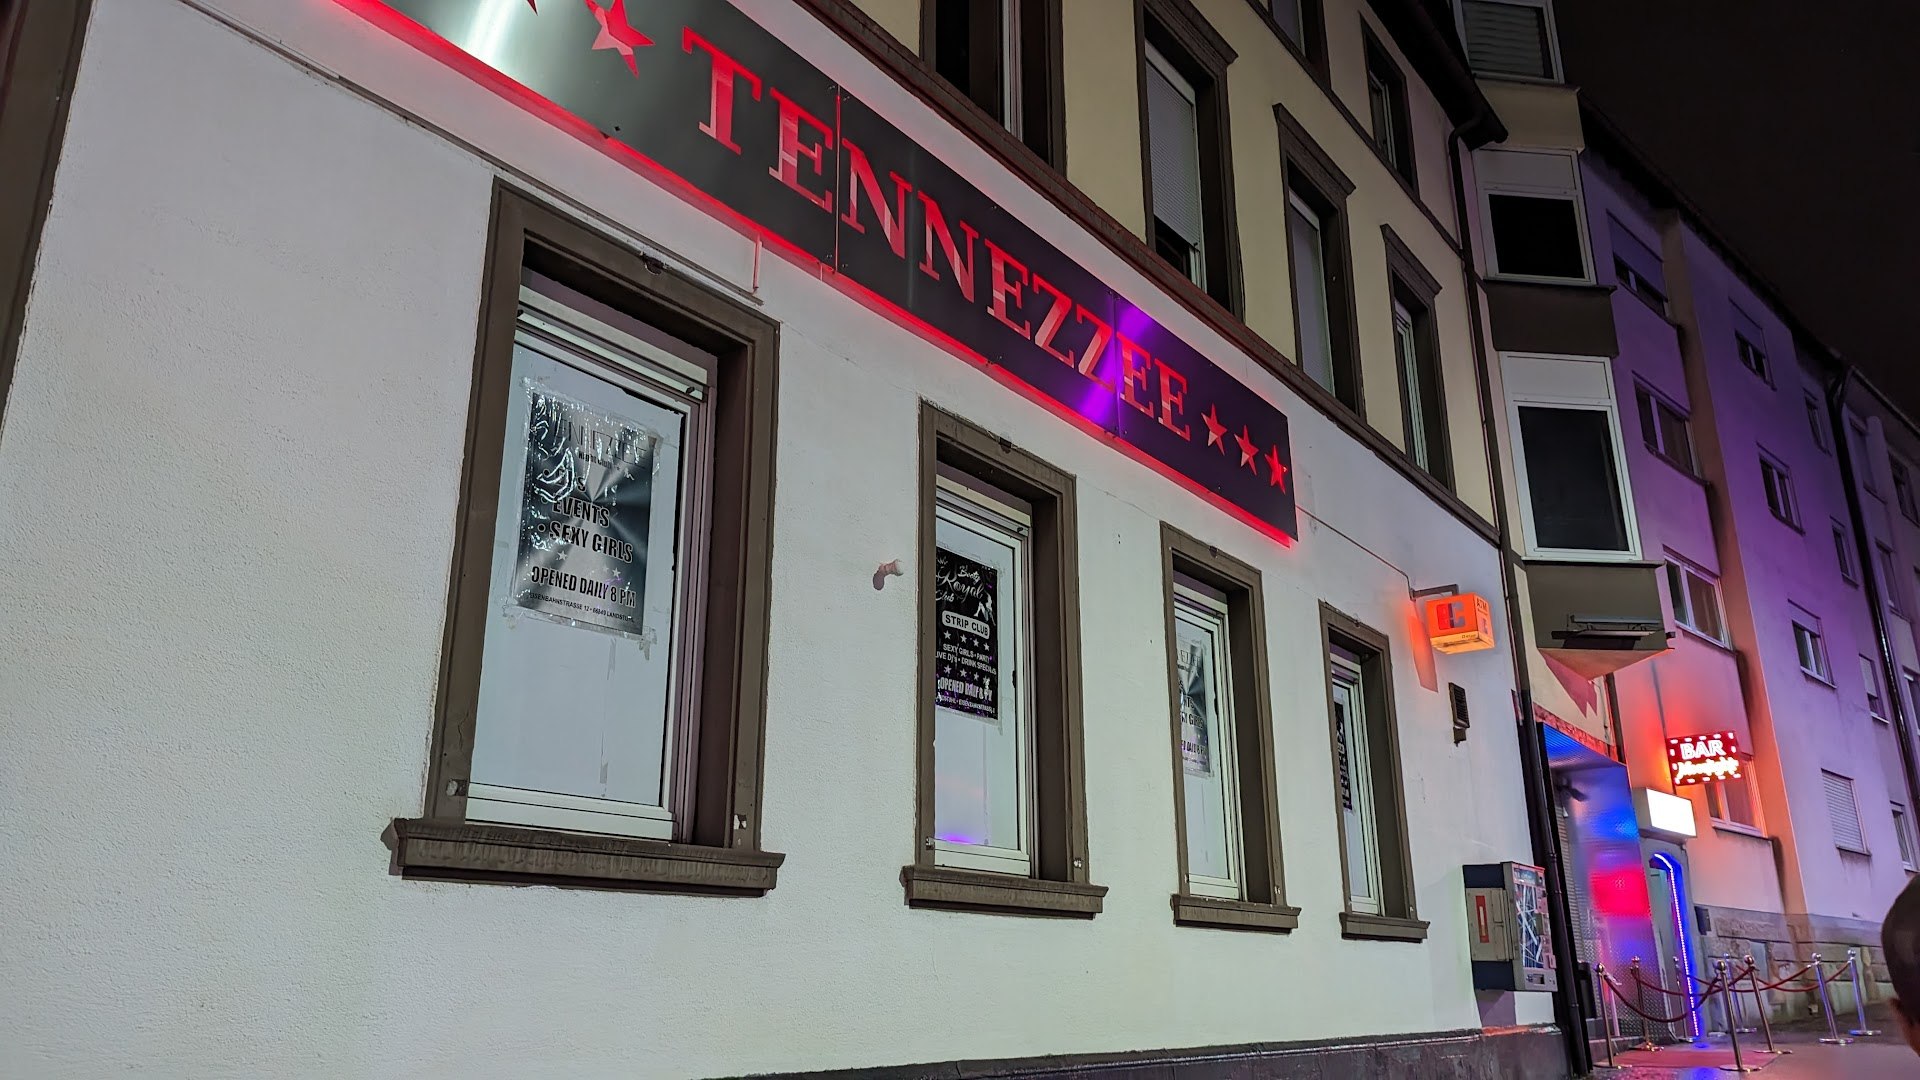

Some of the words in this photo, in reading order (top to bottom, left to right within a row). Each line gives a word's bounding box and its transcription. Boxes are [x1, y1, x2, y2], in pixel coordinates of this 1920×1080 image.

[681, 26, 1191, 441] TENNEZZEE
[553, 496, 610, 527] EVENTS
[549, 521, 589, 548] SEXY
[592, 533, 633, 563] GIRLS
[531, 566, 577, 592] OPENED
[579, 577, 609, 600] DAILY
[610, 586, 617, 603] 8
[619, 588, 636, 608] PM
[945, 614, 969, 629] STRIP
[971, 622, 988, 636] CLUB
[943, 643, 959, 653] SEXY
[959, 647, 974, 658] GIRLS
[961, 657, 977, 668] DRINK
[940, 677, 964, 694] OPENED
[1680, 740, 1727, 760] BAR
